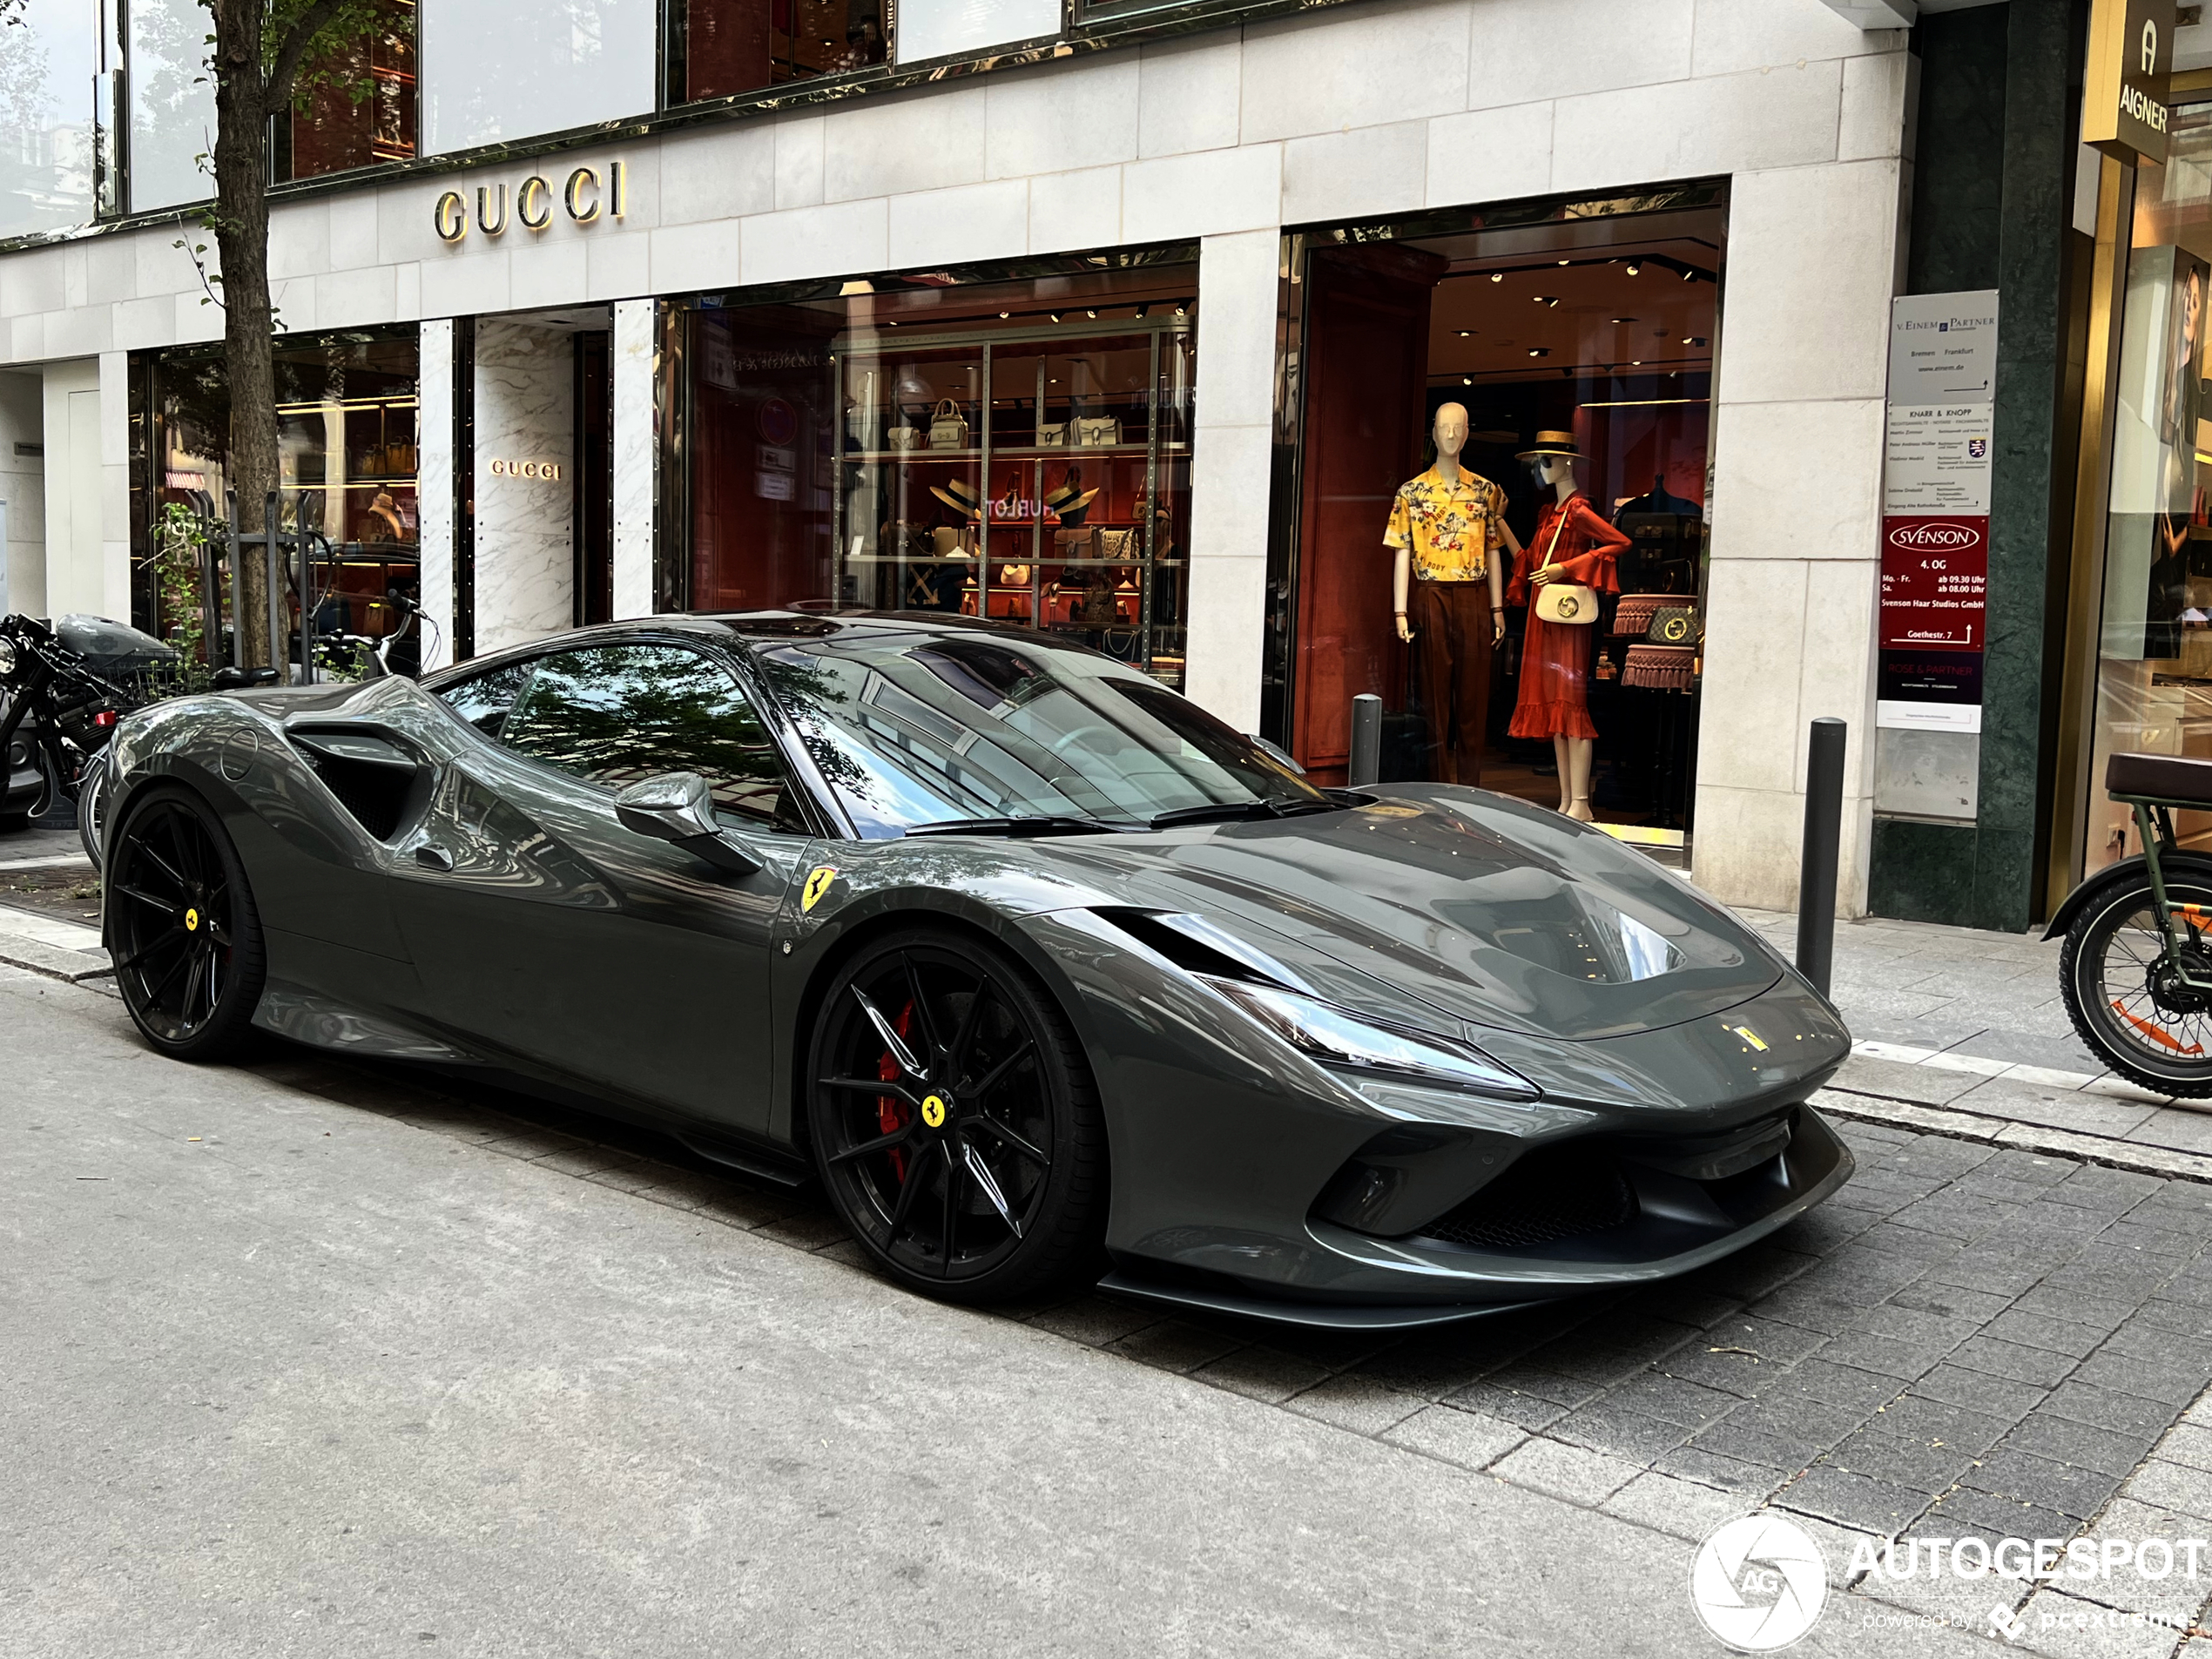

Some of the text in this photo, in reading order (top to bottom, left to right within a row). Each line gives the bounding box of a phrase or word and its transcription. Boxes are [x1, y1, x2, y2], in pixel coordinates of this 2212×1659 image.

[2120, 84, 2168, 133] AIGNER
[435, 162, 624, 241] GUCCI
[1950, 317, 1995, 327] PARTNER
[490, 460, 561, 480] GUCCI
[1898, 530, 1970, 544] SVENSON
[1920, 560, 1946, 570] 4. OG
[1907, 630, 1946, 639] Goethestr.
[1889, 664, 1973, 676] ROSE & PARTNER
